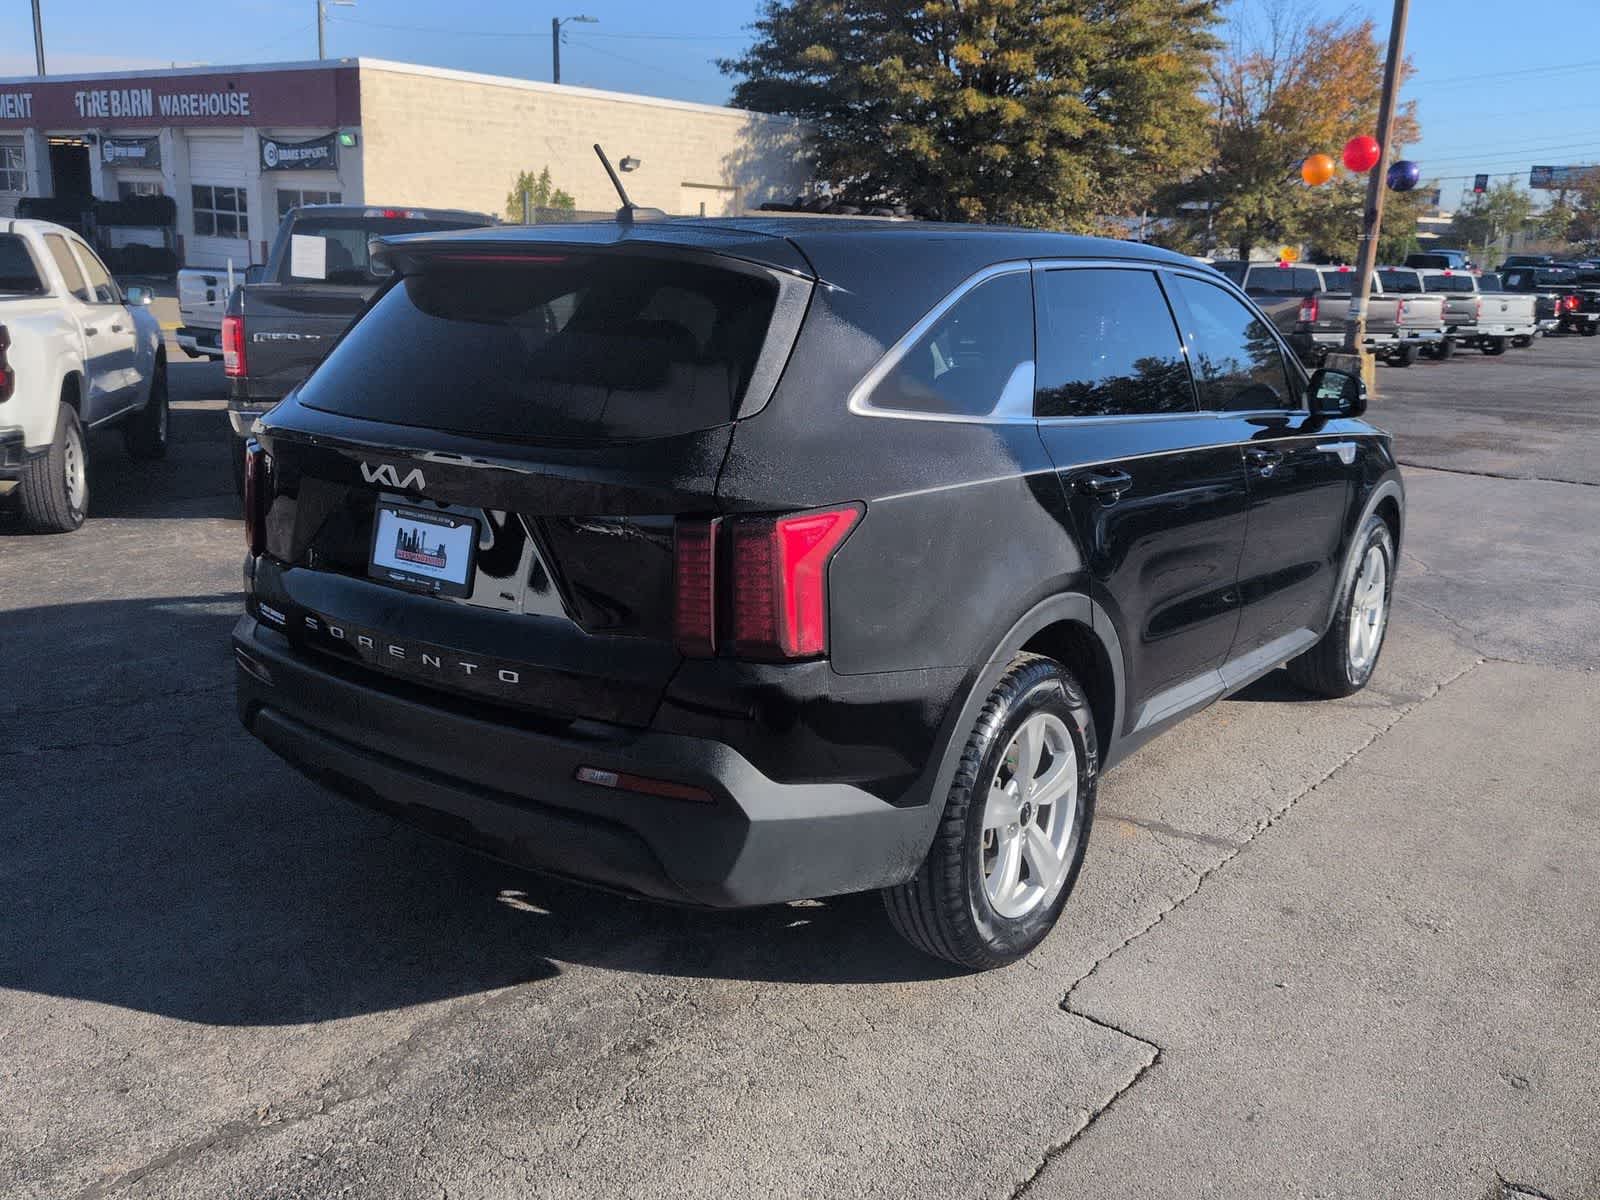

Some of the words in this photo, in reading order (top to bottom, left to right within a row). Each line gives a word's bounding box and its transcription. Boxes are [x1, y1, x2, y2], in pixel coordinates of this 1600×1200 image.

[111, 88, 153, 117] BARN
[159, 92, 250, 116] WAREHOUSE
[361, 461, 426, 490] KIA
[305, 615, 520, 684] SORENTO
